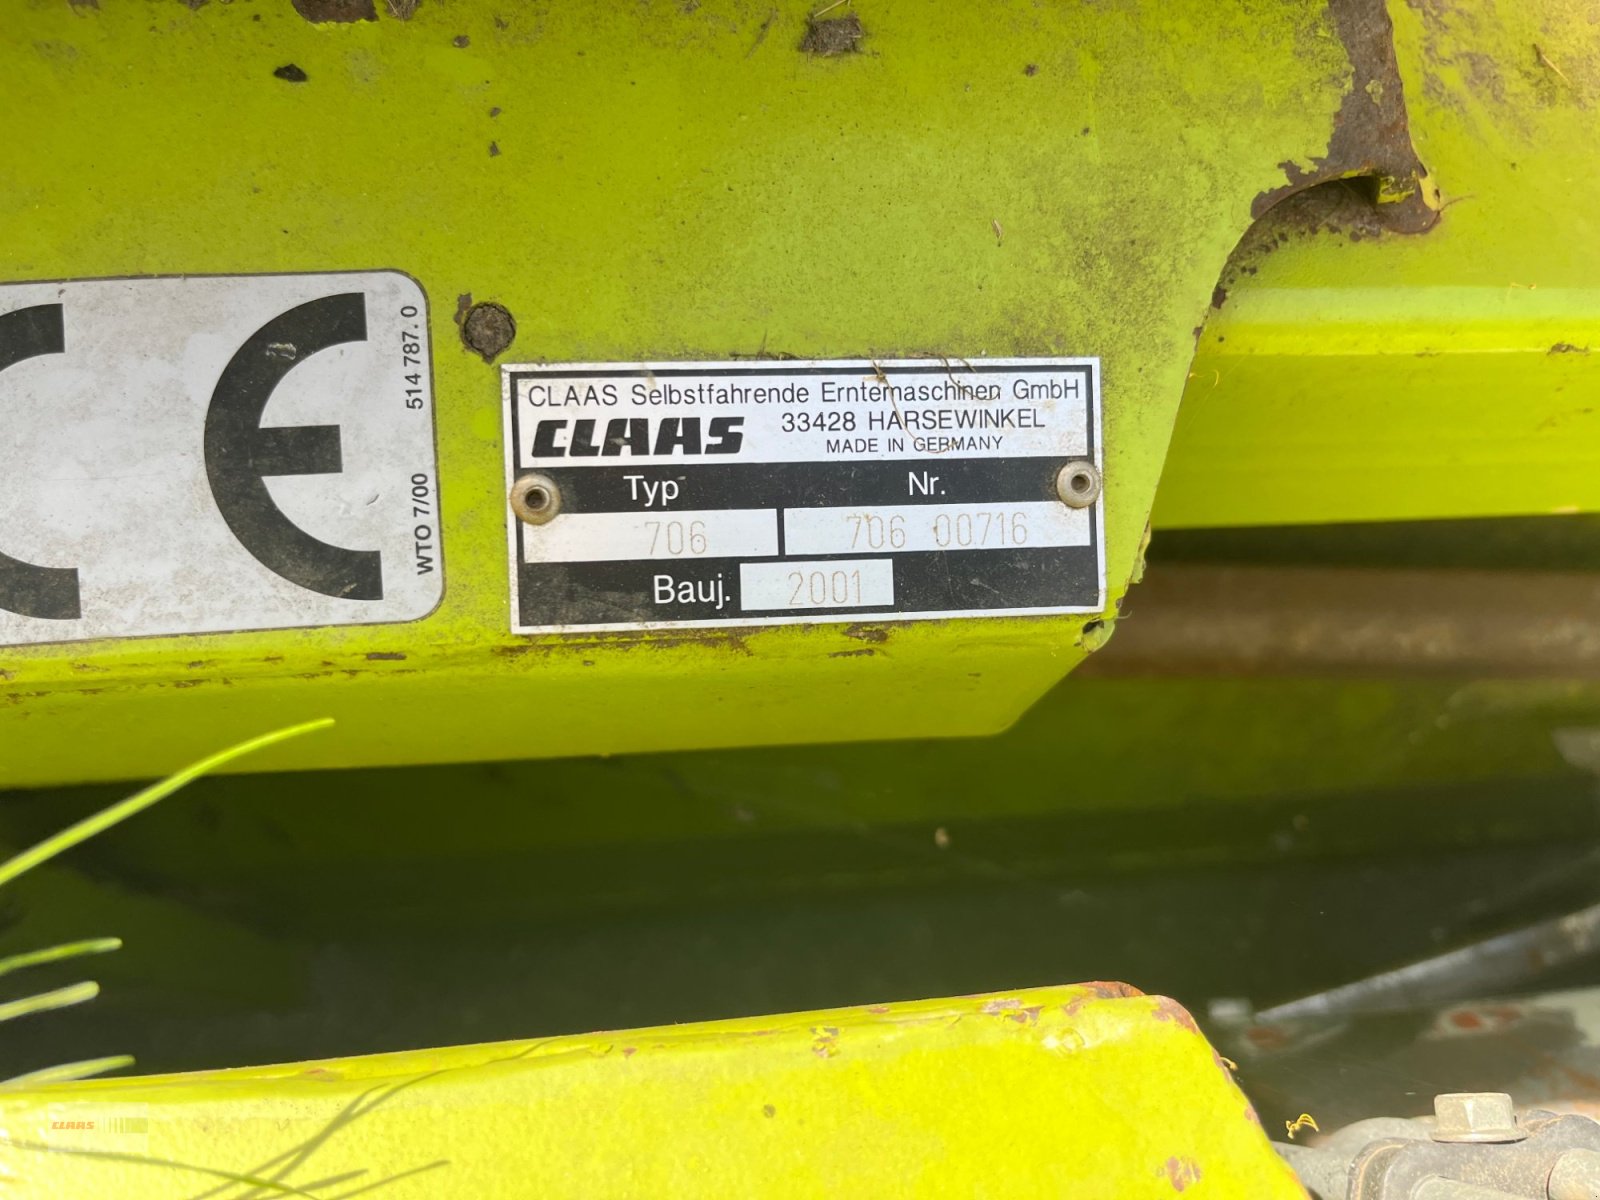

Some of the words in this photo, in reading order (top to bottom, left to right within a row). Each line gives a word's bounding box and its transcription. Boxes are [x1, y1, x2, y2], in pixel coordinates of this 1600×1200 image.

[406, 372, 424, 410] 514
[528, 384, 618, 407] CLAAS
[631, 383, 809, 406] Selbstfahrende
[821, 380, 1001, 402] Erntemaschinen
[1012, 376, 1080, 400] GmbH
[532, 416, 745, 457] CLAAS
[781, 412, 857, 433] 33428
[868, 408, 1046, 431] HARSEWINKEL
[826, 438, 879, 454] MADE
[887, 438, 904, 453] IN
[913, 435, 1004, 452] GERMANY
[411, 472, 430, 518] 7/00
[623, 475, 679, 506] Typ
[908, 471, 947, 496] Nr.
[645, 521, 707, 556] 706
[846, 515, 906, 550] 706
[933, 511, 1029, 547] 00716
[413, 523, 434, 576] WTO
[653, 574, 731, 609] Bauj.
[788, 570, 862, 605] 2001
